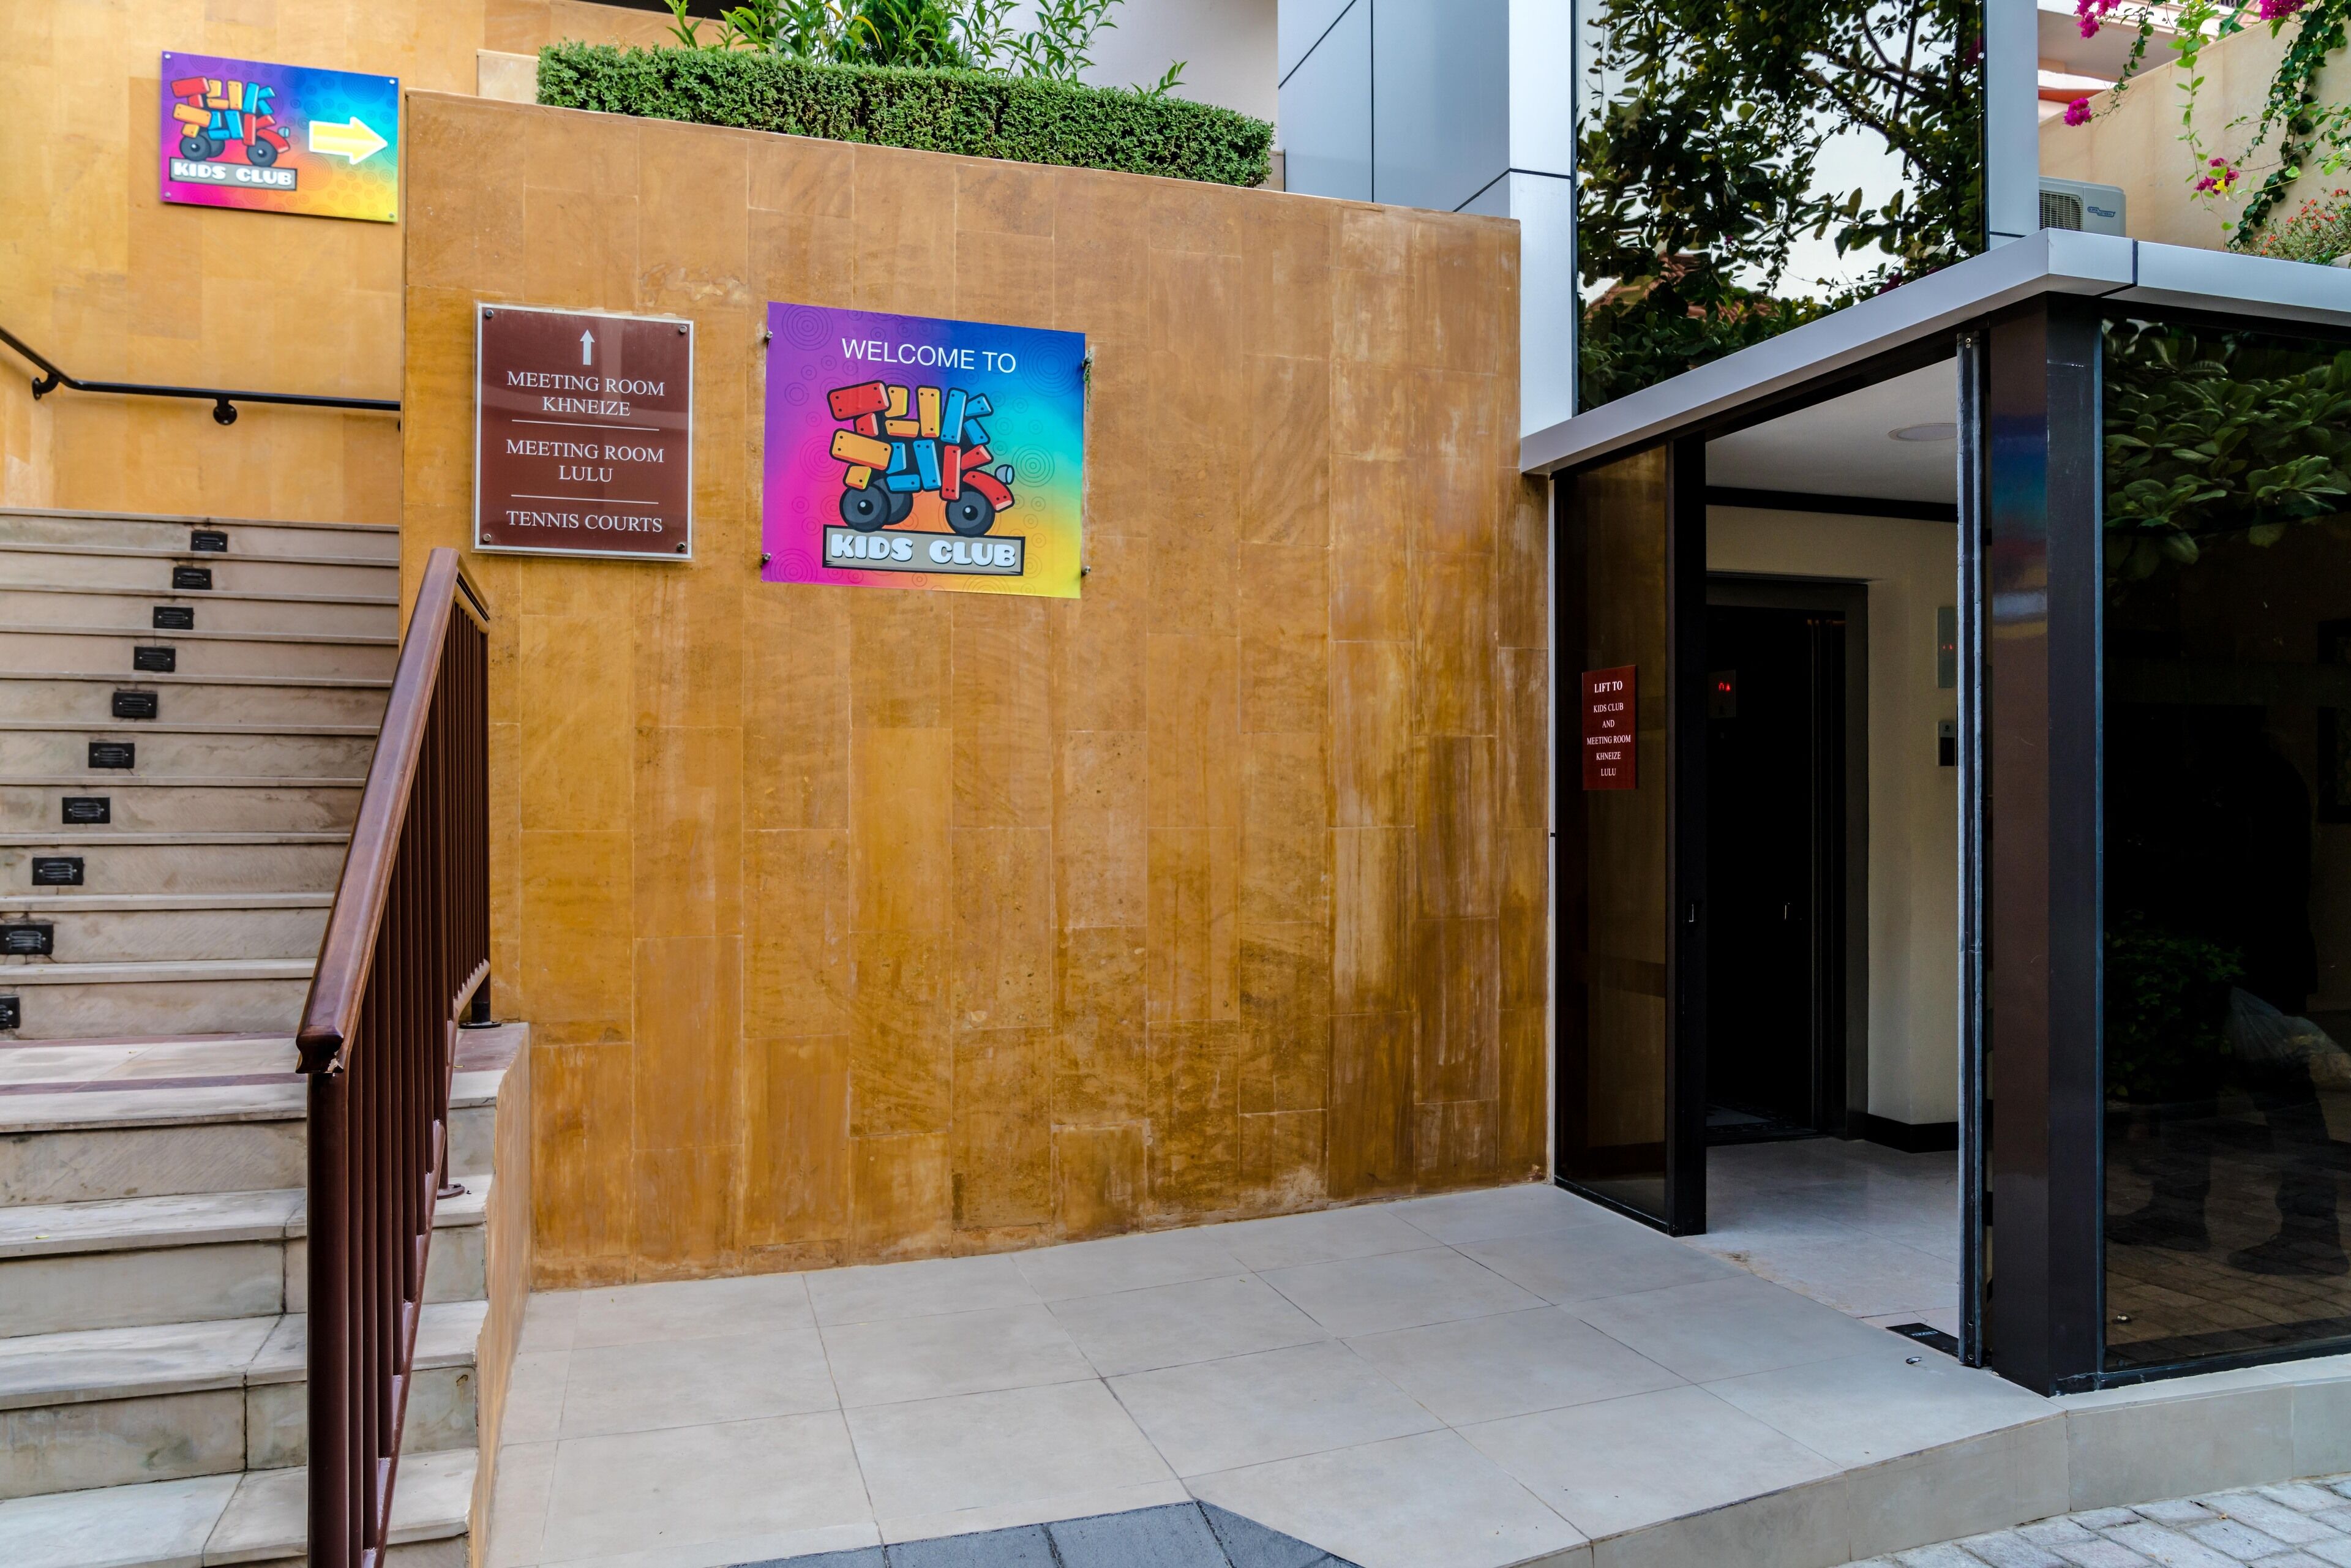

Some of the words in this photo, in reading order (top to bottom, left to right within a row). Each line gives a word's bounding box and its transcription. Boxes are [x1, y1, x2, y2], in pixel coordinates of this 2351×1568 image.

[173, 162, 227, 180] KIDS
[236, 168, 293, 186] CLUB
[841, 338, 975, 370] WELCOME
[983, 351, 1017, 373] TO
[506, 370, 600, 392] MEETING
[605, 378, 665, 397] ROOM
[542, 396, 631, 416] KHNEIZE
[506, 439, 599, 460] MEETING
[604, 445, 664, 463] ROOM
[558, 465, 613, 482] LULU
[506, 510, 579, 529] TENNIS
[585, 514, 663, 533] COURTS
[830, 533, 913, 562] KIDS
[929, 539, 1016, 568] CLUB
[1594, 681, 1611, 693] LIFT
[1612, 680, 1623, 691] TO
[1594, 704, 1607, 713] KIDS
[1608, 702, 1624, 711] CLUB
[1602, 719, 1615, 729] AND
[1586, 736, 1612, 745] MEETING
[1613, 734, 1631, 743] ROOM
[1596, 751, 1621, 760] KHNEIZE
[1601, 768, 1616, 776] LULU
